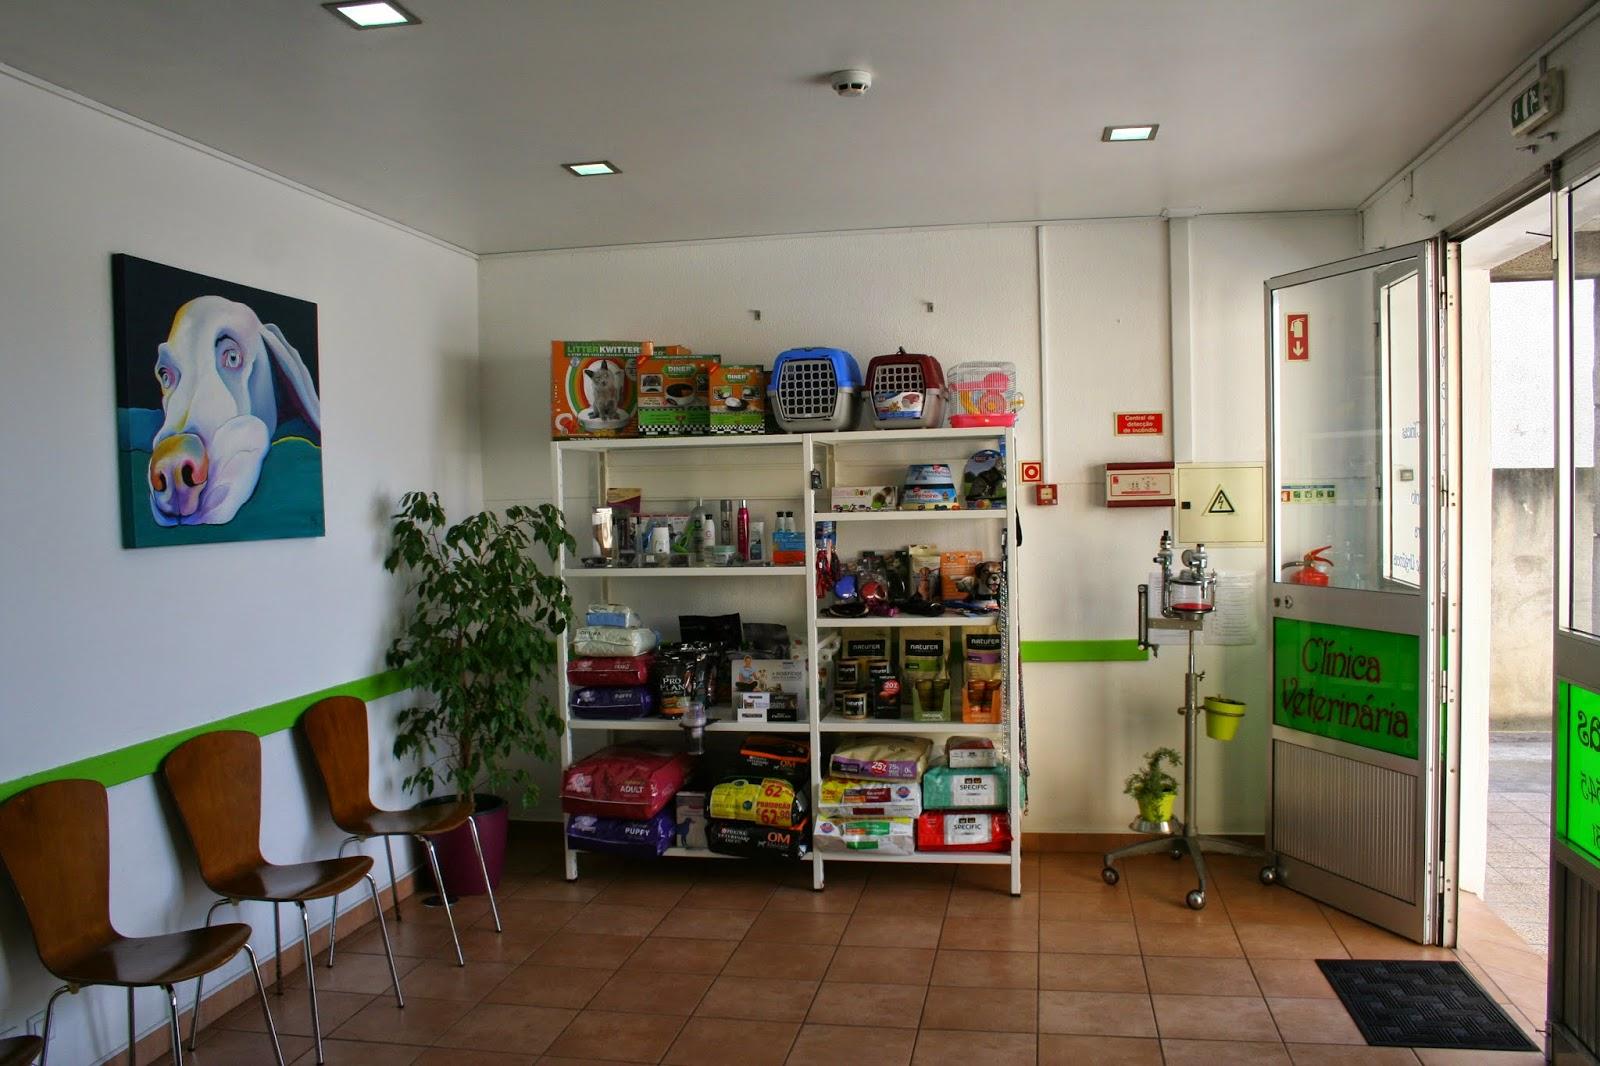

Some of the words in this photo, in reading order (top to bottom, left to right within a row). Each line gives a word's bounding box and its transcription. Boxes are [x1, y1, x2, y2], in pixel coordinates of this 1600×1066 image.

[1301, 637, 1381, 684] Clínica
[1281, 678, 1409, 739] Veterinária
[620, 785, 645, 793] ADULT
[959, 783, 988, 791] SPECIFIC
[625, 826, 650, 837] PUPPY
[953, 823, 982, 831] SPECIFIC
[768, 831, 791, 845] OM
